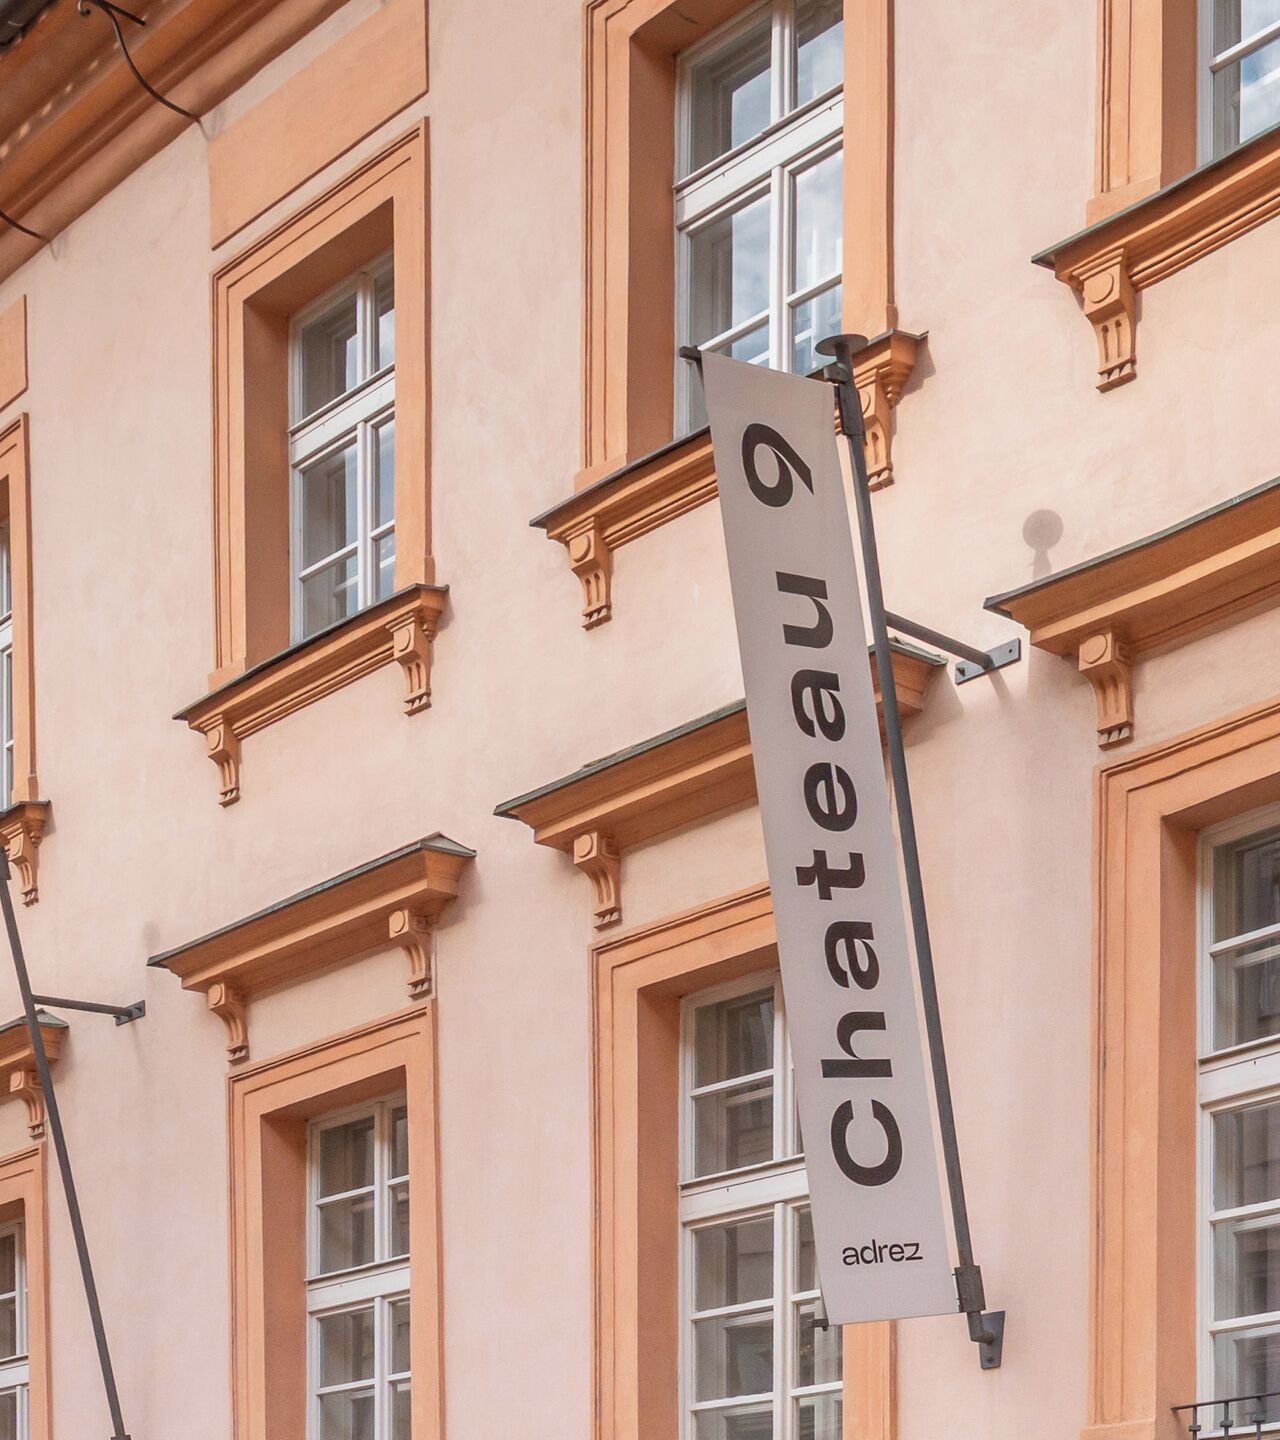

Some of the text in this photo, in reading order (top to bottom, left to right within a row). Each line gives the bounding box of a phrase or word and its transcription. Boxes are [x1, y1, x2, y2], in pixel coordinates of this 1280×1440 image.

[742, 422, 903, 1188] Chateau 9
[841, 1238, 924, 1266] adrez
